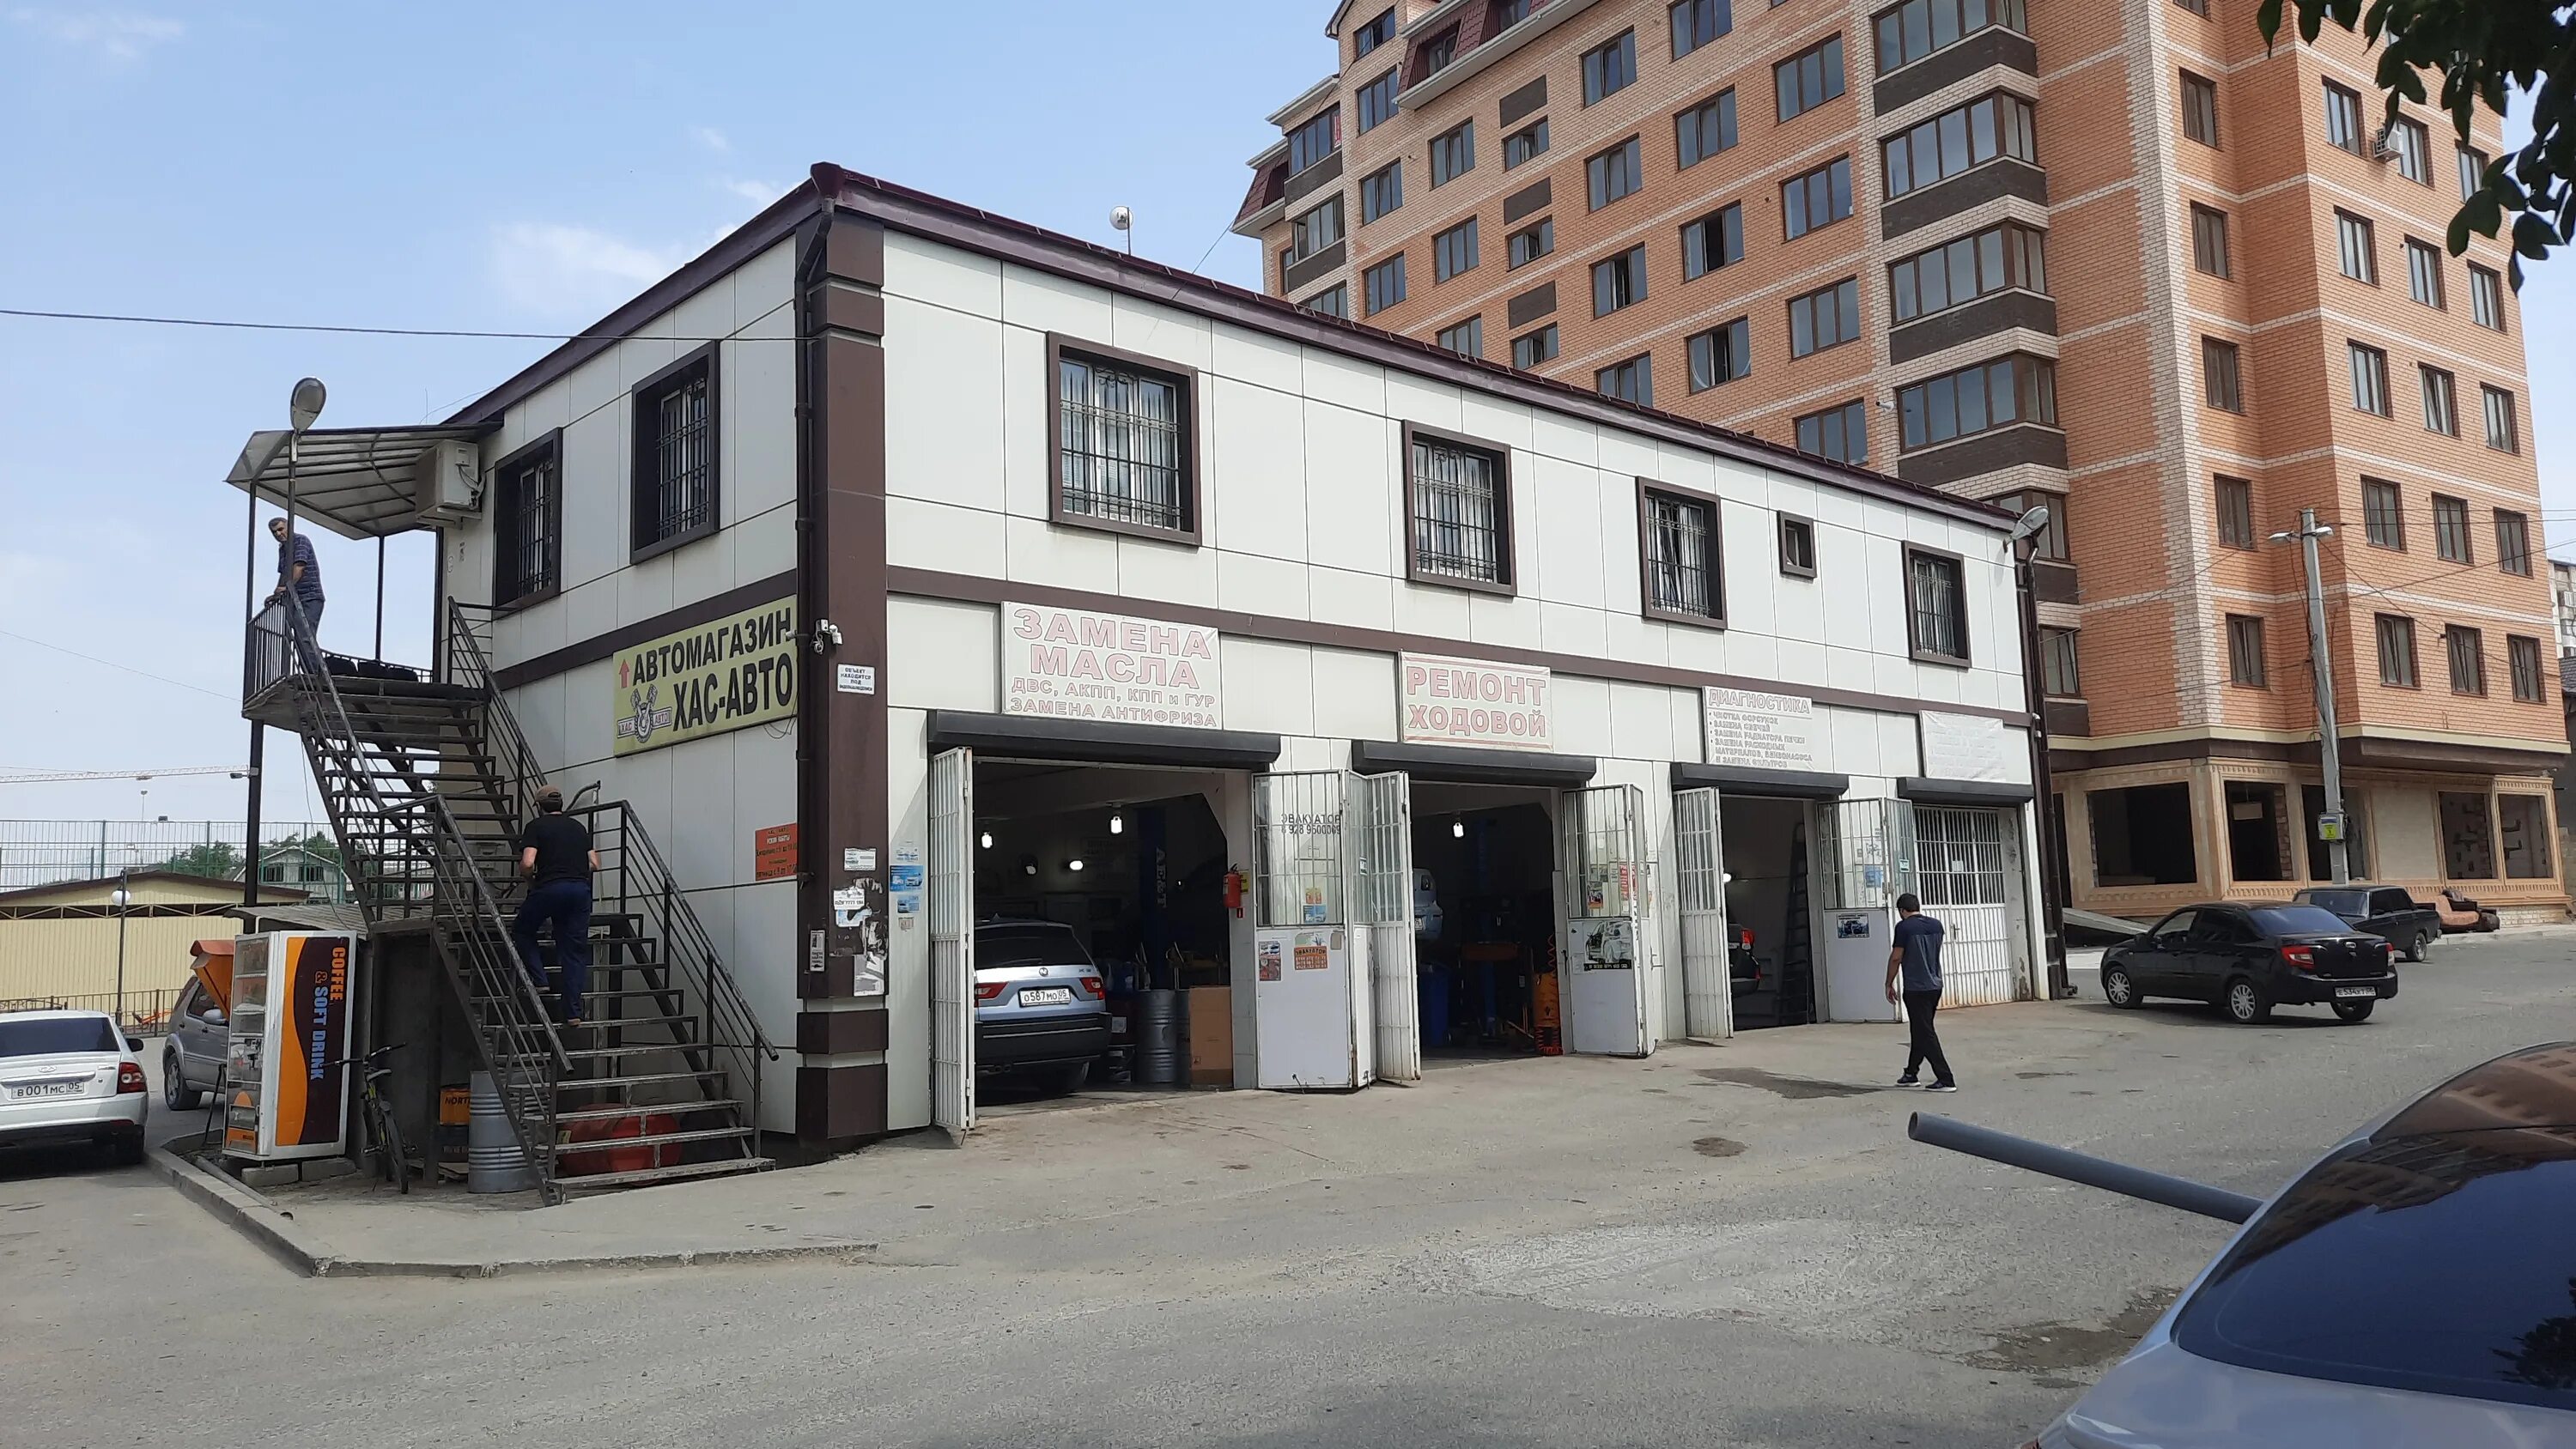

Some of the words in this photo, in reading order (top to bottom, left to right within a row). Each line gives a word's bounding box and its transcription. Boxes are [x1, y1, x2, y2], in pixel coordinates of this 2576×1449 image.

[632, 607, 791, 686] АВТОМАГАЗИН
[1013, 608, 1212, 659] ЗАМЕНА
[1030, 643, 1200, 689] МАСЛА
[672, 652, 793, 731] ХАС-АВТО
[1012, 676, 1059, 697] ДВС,
[1065, 682, 1121, 702] АКПП,
[1127, 688, 1163, 704] КПП
[1184, 693, 1216, 708] ГУР
[1406, 665, 1546, 706] РЕМОНТ
[1709, 688, 1810, 714] ДИАГНОСТИКА
[1010, 697, 1096, 718] ЗАМЕНА
[1101, 706, 1218, 727] АНТИФРИЗА
[1408, 704, 1546, 737] ХОДОВОЙ
[1714, 719, 1742, 731] ЗАМЕНА
[1714, 729, 1743, 739] ЗАМЕНА
[1715, 737, 1743, 748] ЗАМЕНА
[1281, 813, 1340, 824] ЭВАКУАТОР
[314, 971, 328, 984] &
[330, 947, 346, 1001] COFFEE
[313, 986, 329, 1026] SOFT
[310, 1030, 326, 1081] DRINK
[17, 1085, 65, 1097] В001МС
